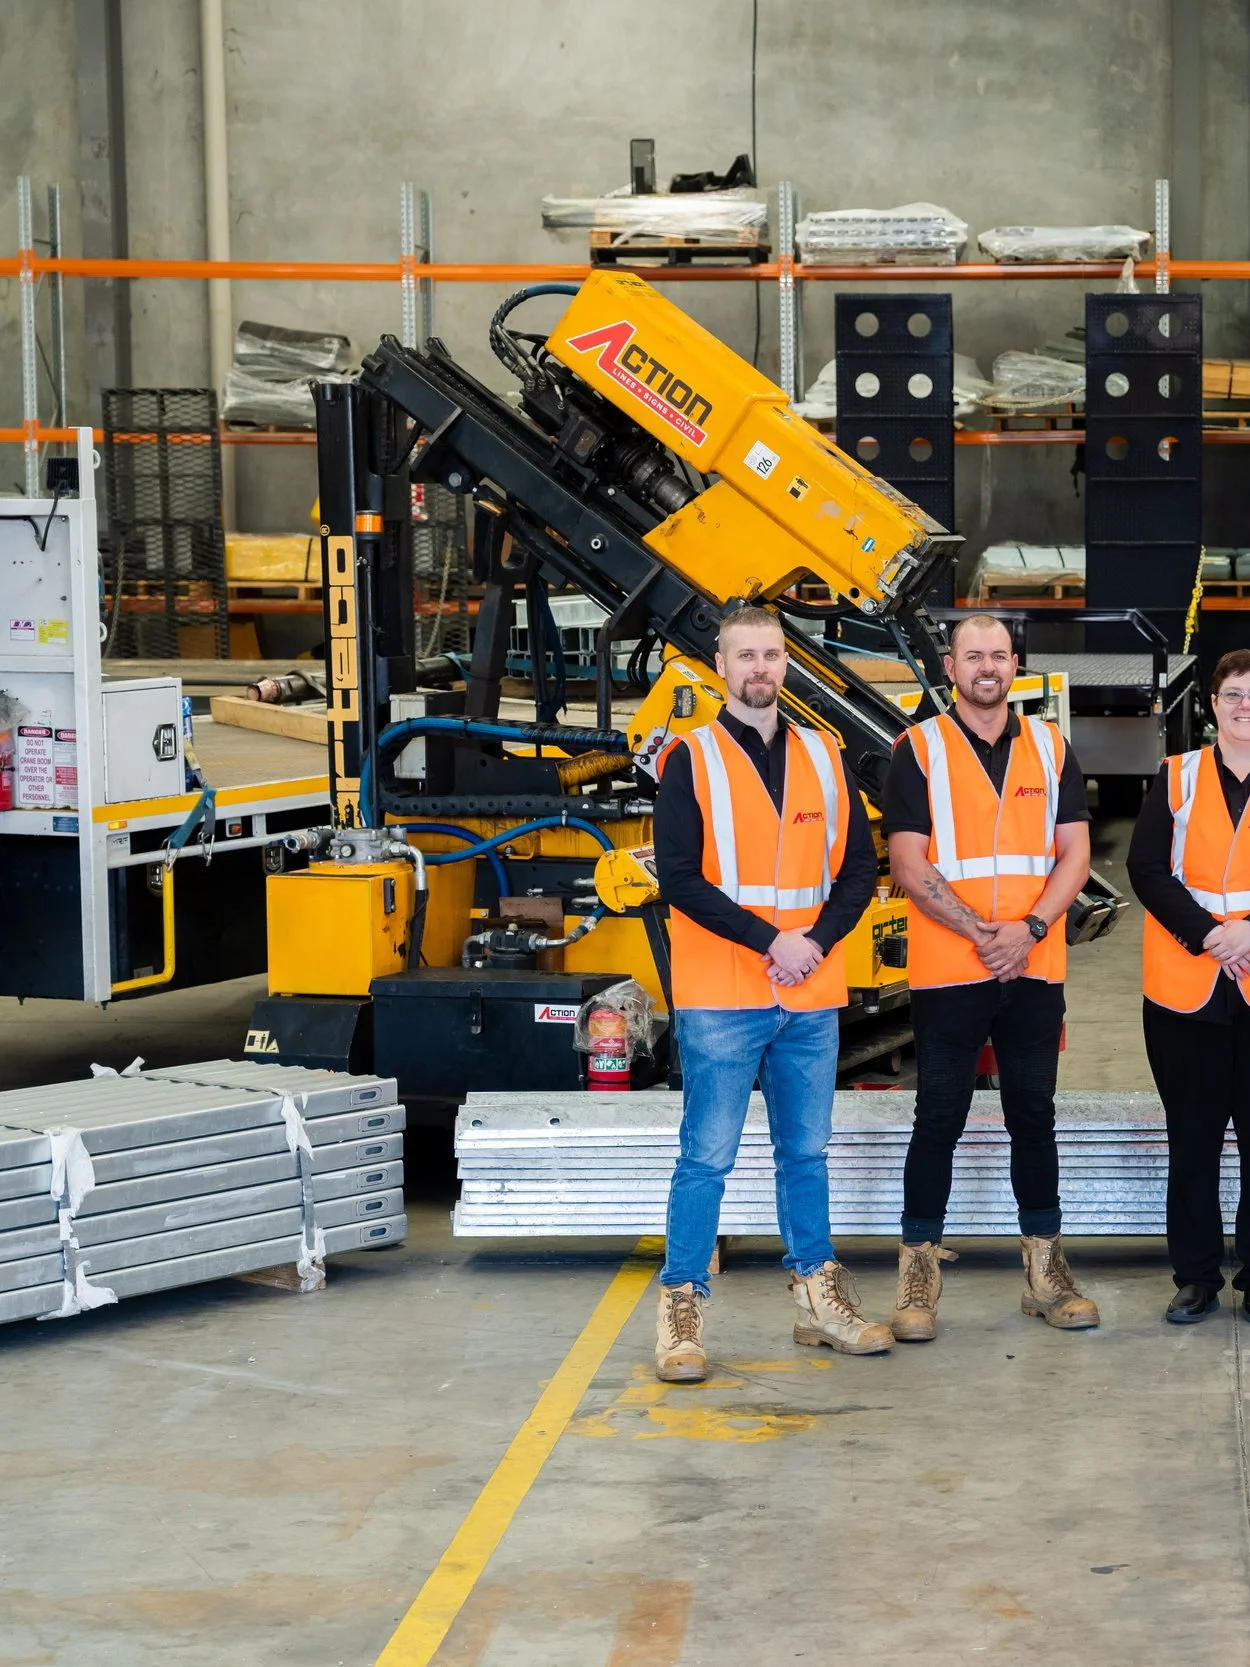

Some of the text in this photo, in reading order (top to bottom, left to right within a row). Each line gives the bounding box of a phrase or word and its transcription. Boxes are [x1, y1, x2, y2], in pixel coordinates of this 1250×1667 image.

[565, 320, 713, 427] ACTION
[612, 367, 696, 438] LINES SIGNS CIVIL
[757, 457, 772, 475] 126
[22, 793, 50, 801] PERSONNEL
[538, 1007, 576, 1020] ACTION
